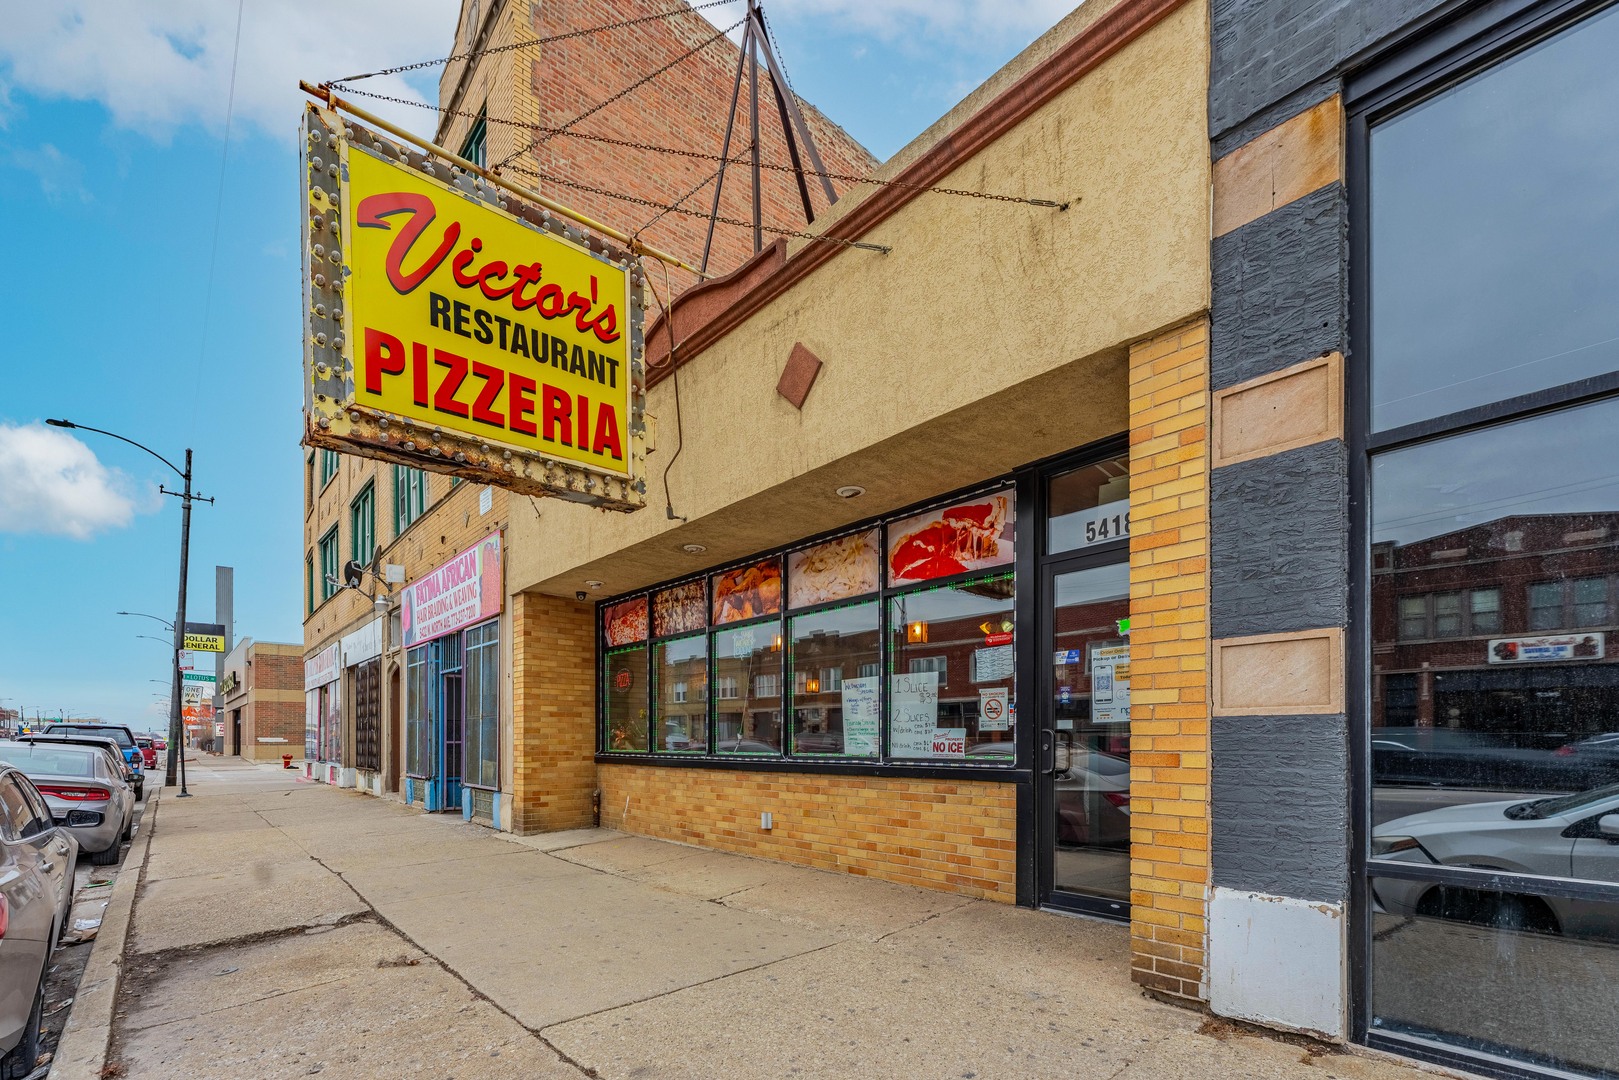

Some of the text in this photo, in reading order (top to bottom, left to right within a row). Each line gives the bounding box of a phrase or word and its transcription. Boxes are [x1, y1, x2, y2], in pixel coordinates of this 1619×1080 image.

[357, 192, 620, 343] Victor's
[429, 292, 619, 388] RESTAURANT
[364, 327, 622, 460] PIZZERIA
[416, 550, 477, 607] FATIMA AFRICAN
[416, 607, 427, 625] HAIR
[428, 596, 449, 620] BRAIDING
[453, 581, 477, 607] WEAVING
[616, 672, 630, 688] PIZZA
[895, 678, 901, 693] 1
[893, 709, 901, 723] 2
[933, 742, 946, 752] NO
[948, 742, 964, 753] ICE
